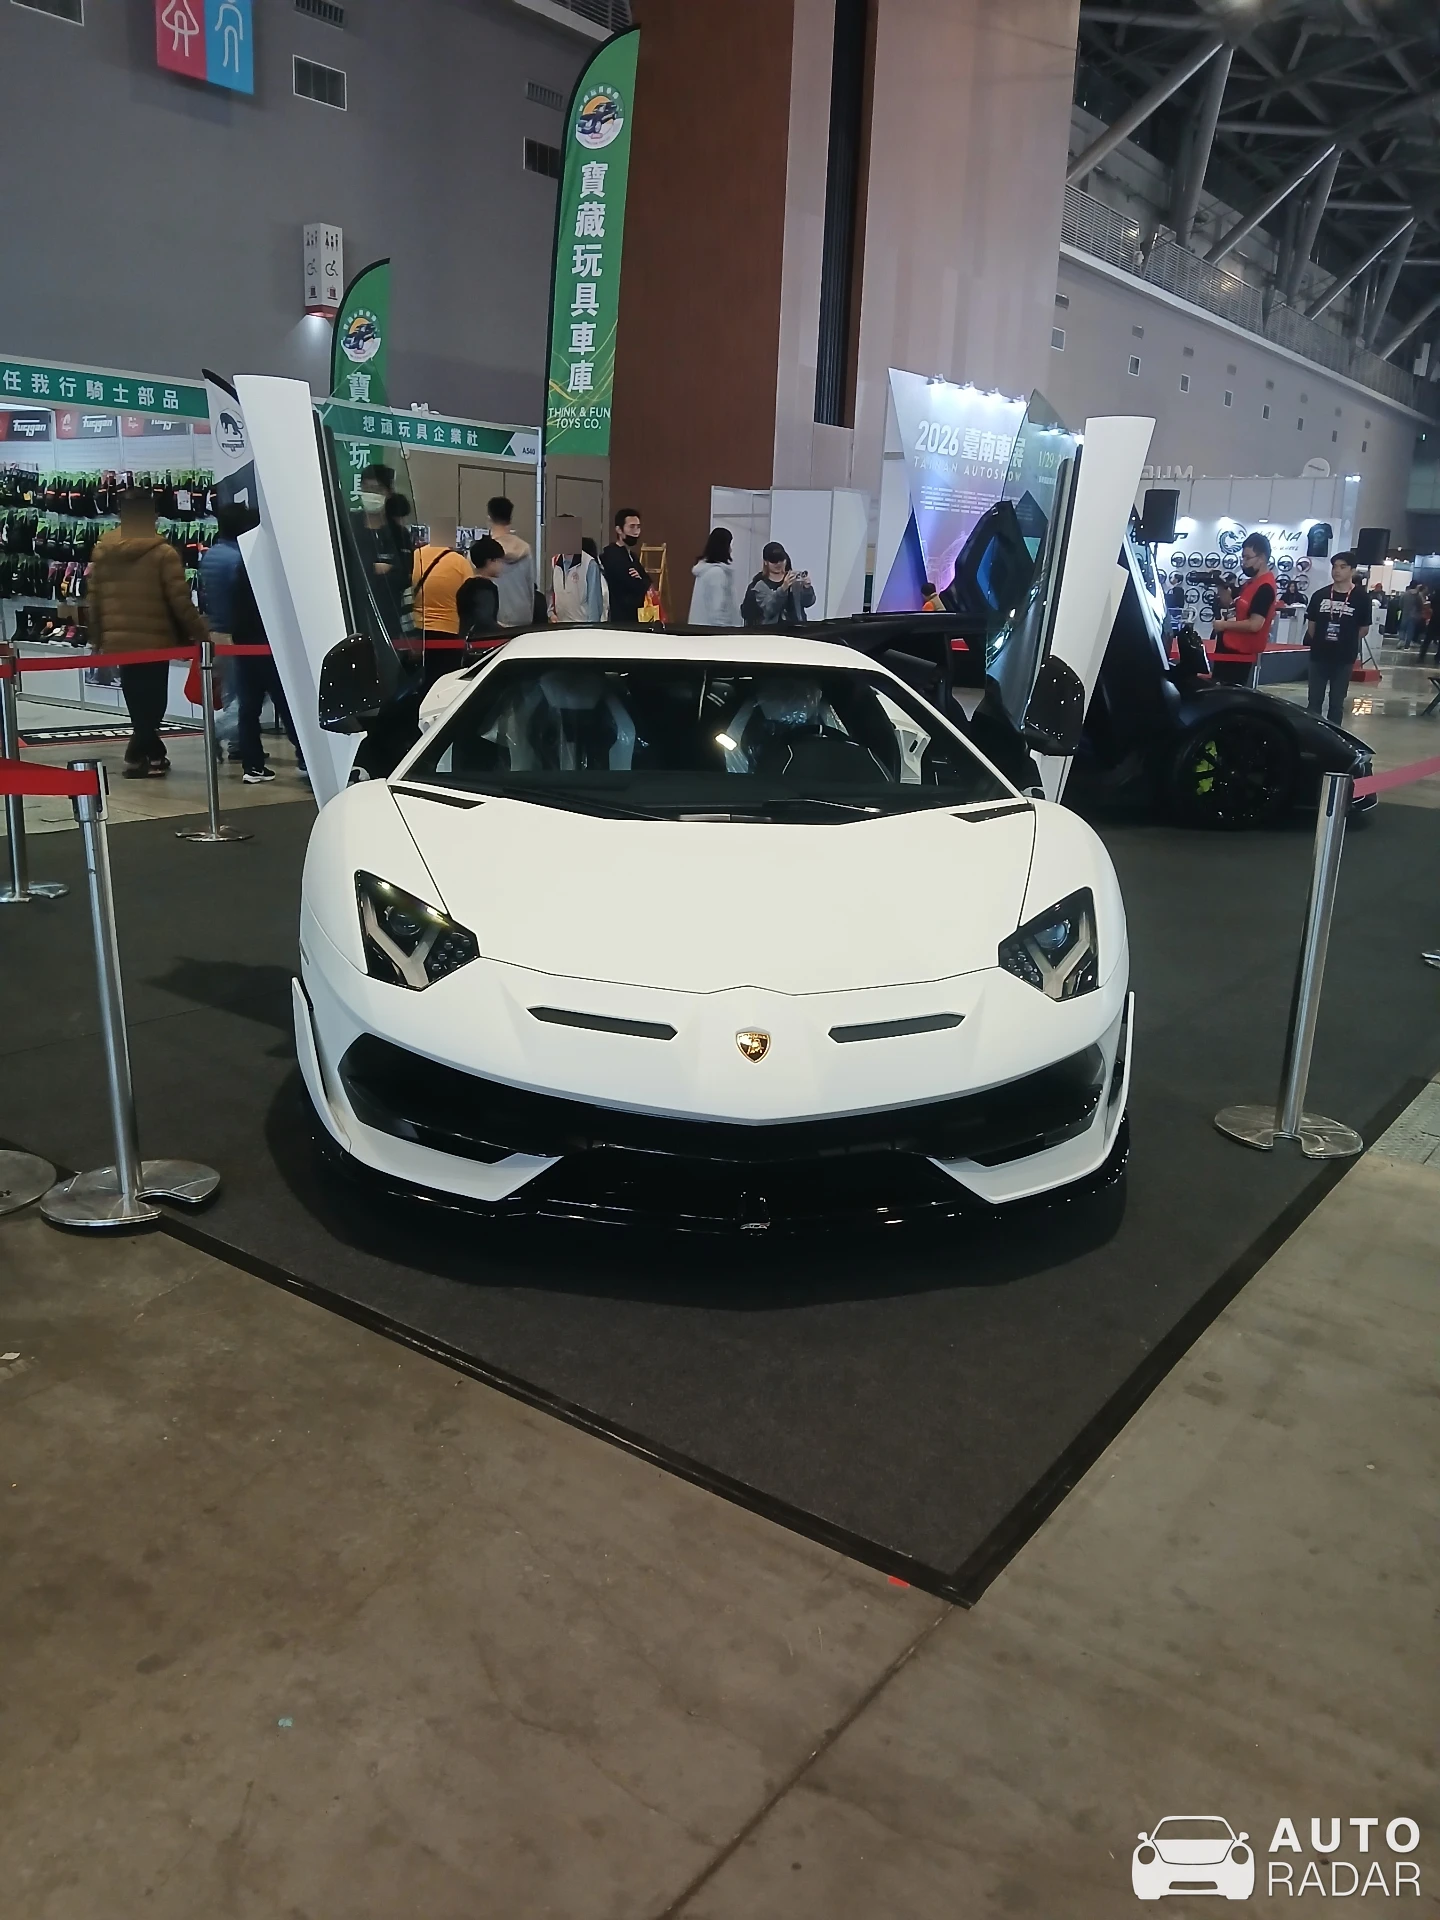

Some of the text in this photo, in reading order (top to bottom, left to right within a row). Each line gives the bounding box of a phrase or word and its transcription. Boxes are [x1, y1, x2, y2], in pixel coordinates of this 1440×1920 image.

[567, 161, 609, 393] 寶藏玩具車庫
[2, 369, 179, 410] 任我行騎士部品
[548, 406, 611, 418] THINK & FUN
[556, 418, 602, 430] TOYS CO.
[362, 414, 479, 447] 想頑玩具企業社
[914, 420, 1026, 468] 2026 臺南車展
[914, 455, 958, 472] TAINAN
[963, 468, 1022, 482] AUTOSHOW
